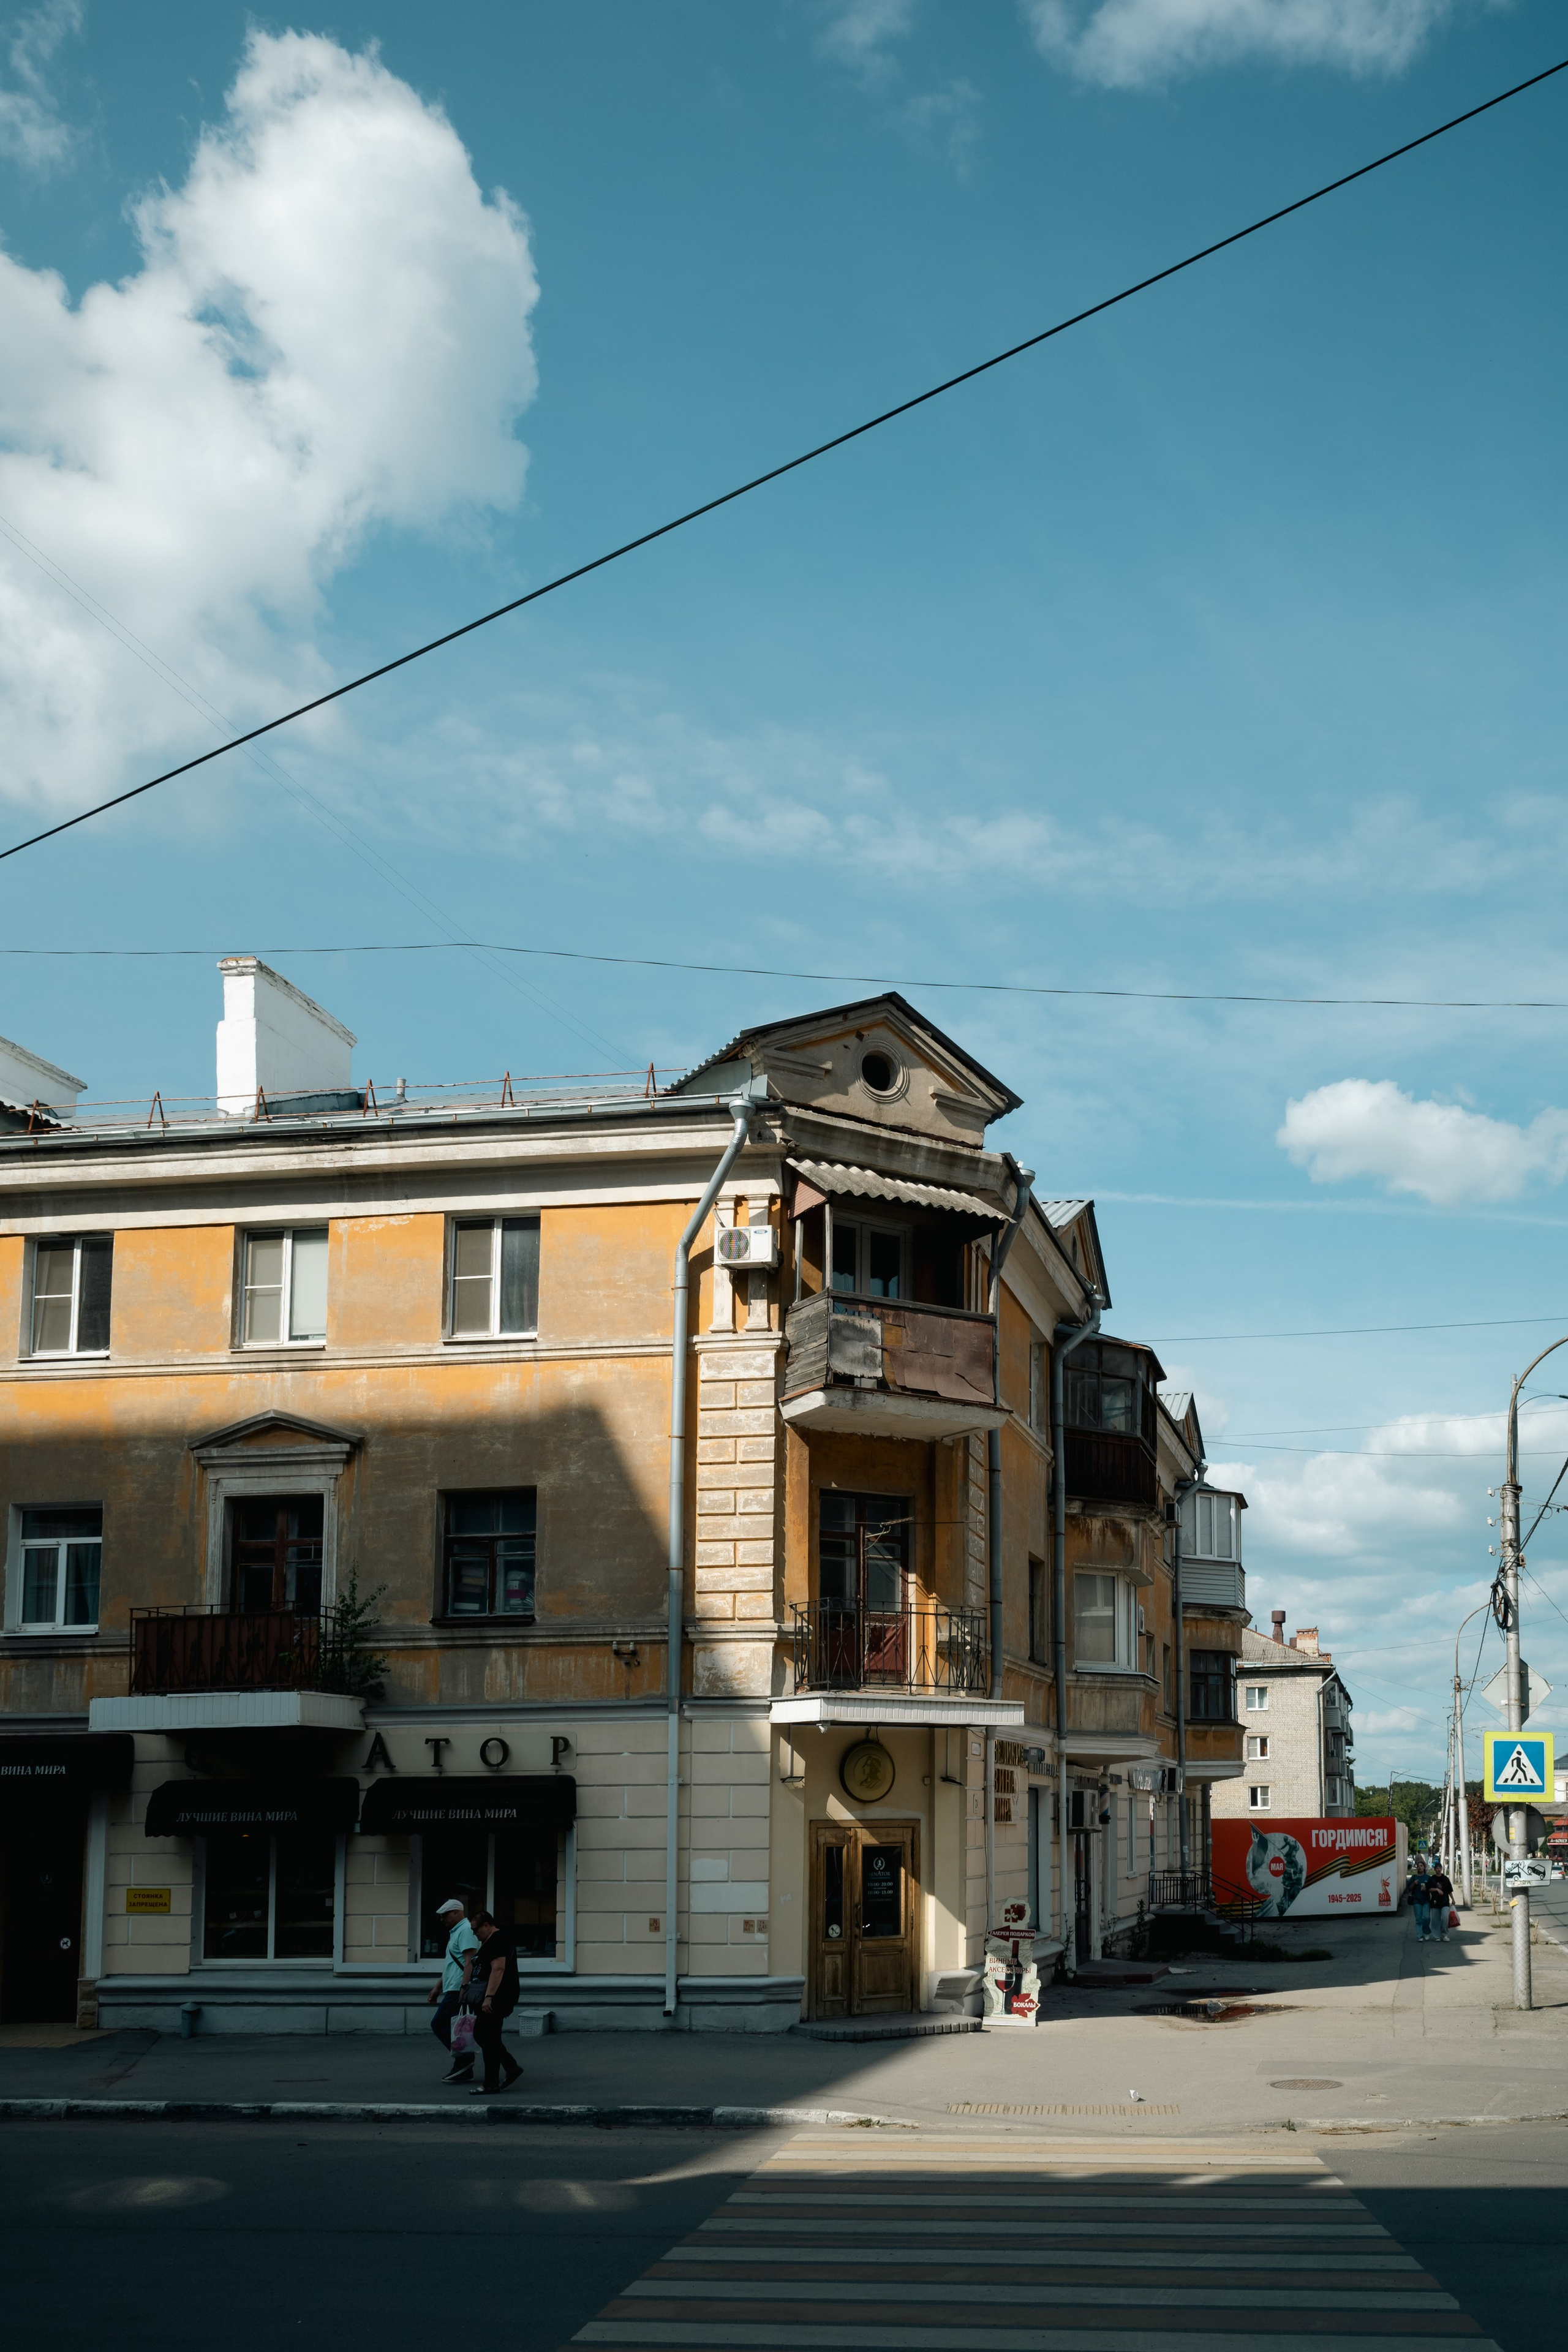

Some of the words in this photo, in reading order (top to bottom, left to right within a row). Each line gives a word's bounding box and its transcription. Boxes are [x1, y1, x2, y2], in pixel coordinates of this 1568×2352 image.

[0, 1766, 32, 1775] ВИНА
[35, 1765, 66, 1774] МИРА
[994, 1768, 1016, 1793] ВИНА
[176, 1812, 228, 1822] ЛУЧШИЕ
[230, 1812, 262, 1822] ВИНА
[265, 1811, 298, 1821] МИРА
[392, 1809, 446, 1819] ЛУЧШИЕ
[448, 1809, 481, 1819] ВИНА
[484, 1808, 517, 1819] МИРА
[994, 1798, 1012, 1822] МИРА
[1311, 1828, 1388, 1850] ГОРДИМСЯ!
